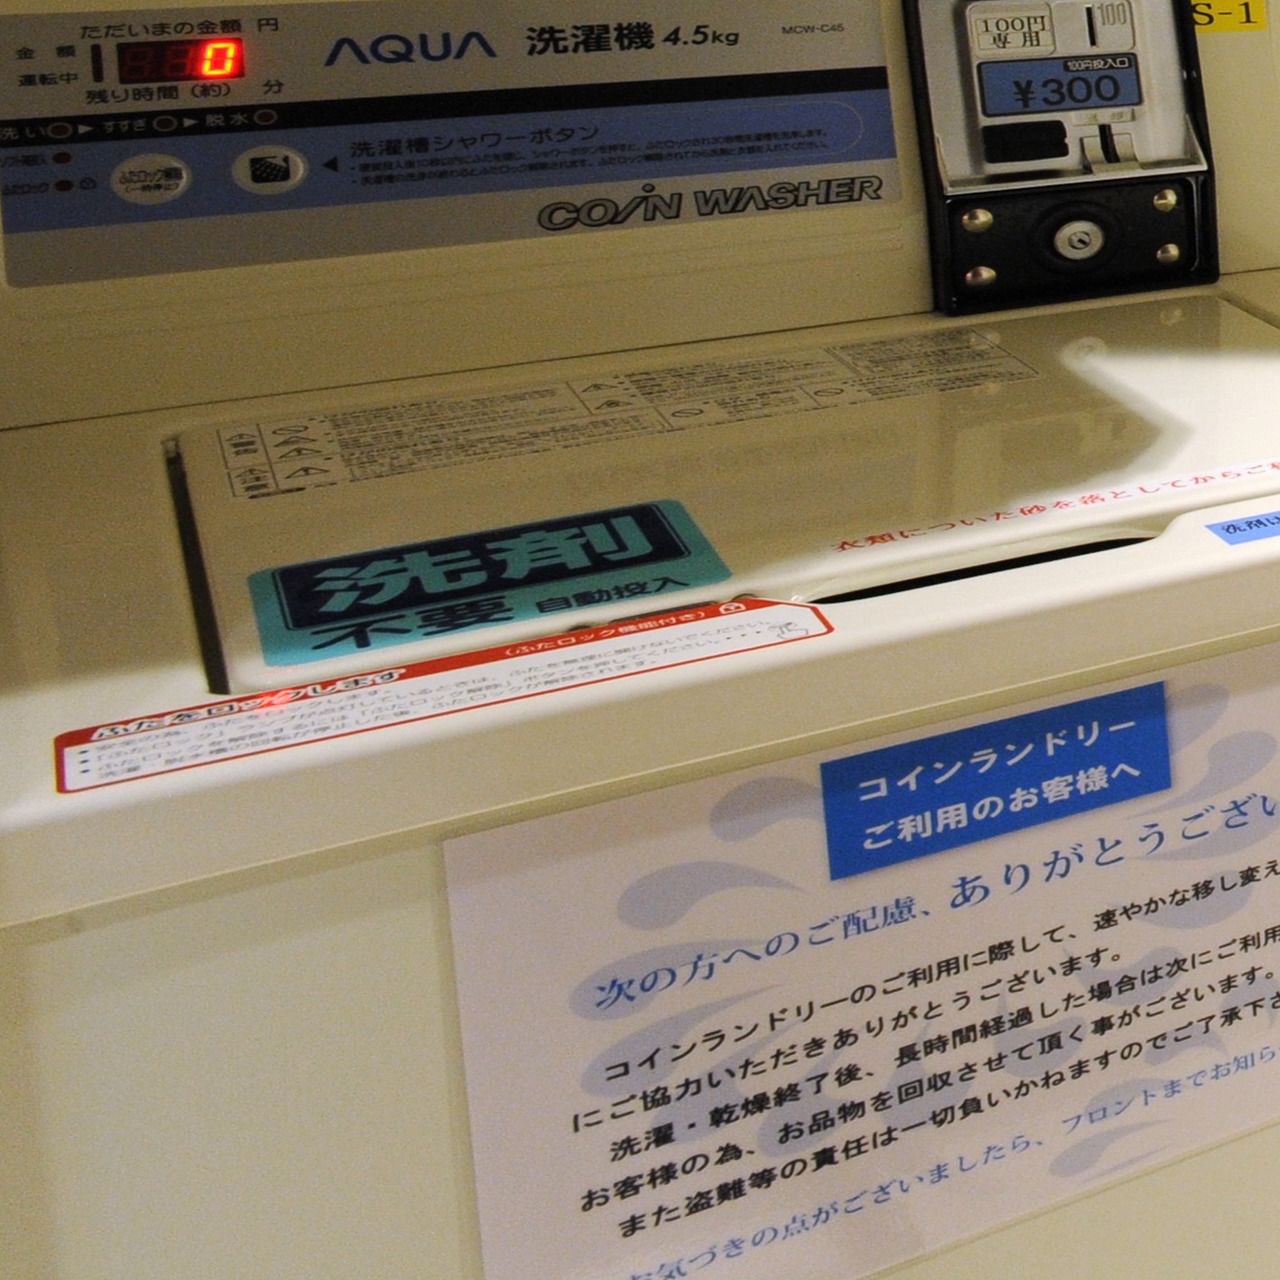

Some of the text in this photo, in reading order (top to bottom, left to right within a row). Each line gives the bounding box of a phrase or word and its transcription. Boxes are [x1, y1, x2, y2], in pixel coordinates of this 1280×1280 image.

[80, 17, 279, 40] ただいまの金額 円
[323, 22, 740, 67] AQUA 洗濯機 4.5kg
[979, 15, 1047, 35] 100円
[17, 70, 79, 88] 運転中
[201, 40, 237, 78] 0
[262, 79, 284, 95] 分
[1012, 74, 1121, 109] ¥300
[693, 174, 883, 216] WASHER
[312, 516, 653, 614] 洗剤
[309, 575, 692, 652] 不要 自動投入
[857, 719, 1137, 802] コインランドリー
[862, 761, 1142, 851] ご利用のお客様へ
[572, 948, 1123, 1133] にご協力いただきありがとうございます。
[580, 965, 1277, 1213] お客様の為、お品物を回収させて頂く事がございます。
